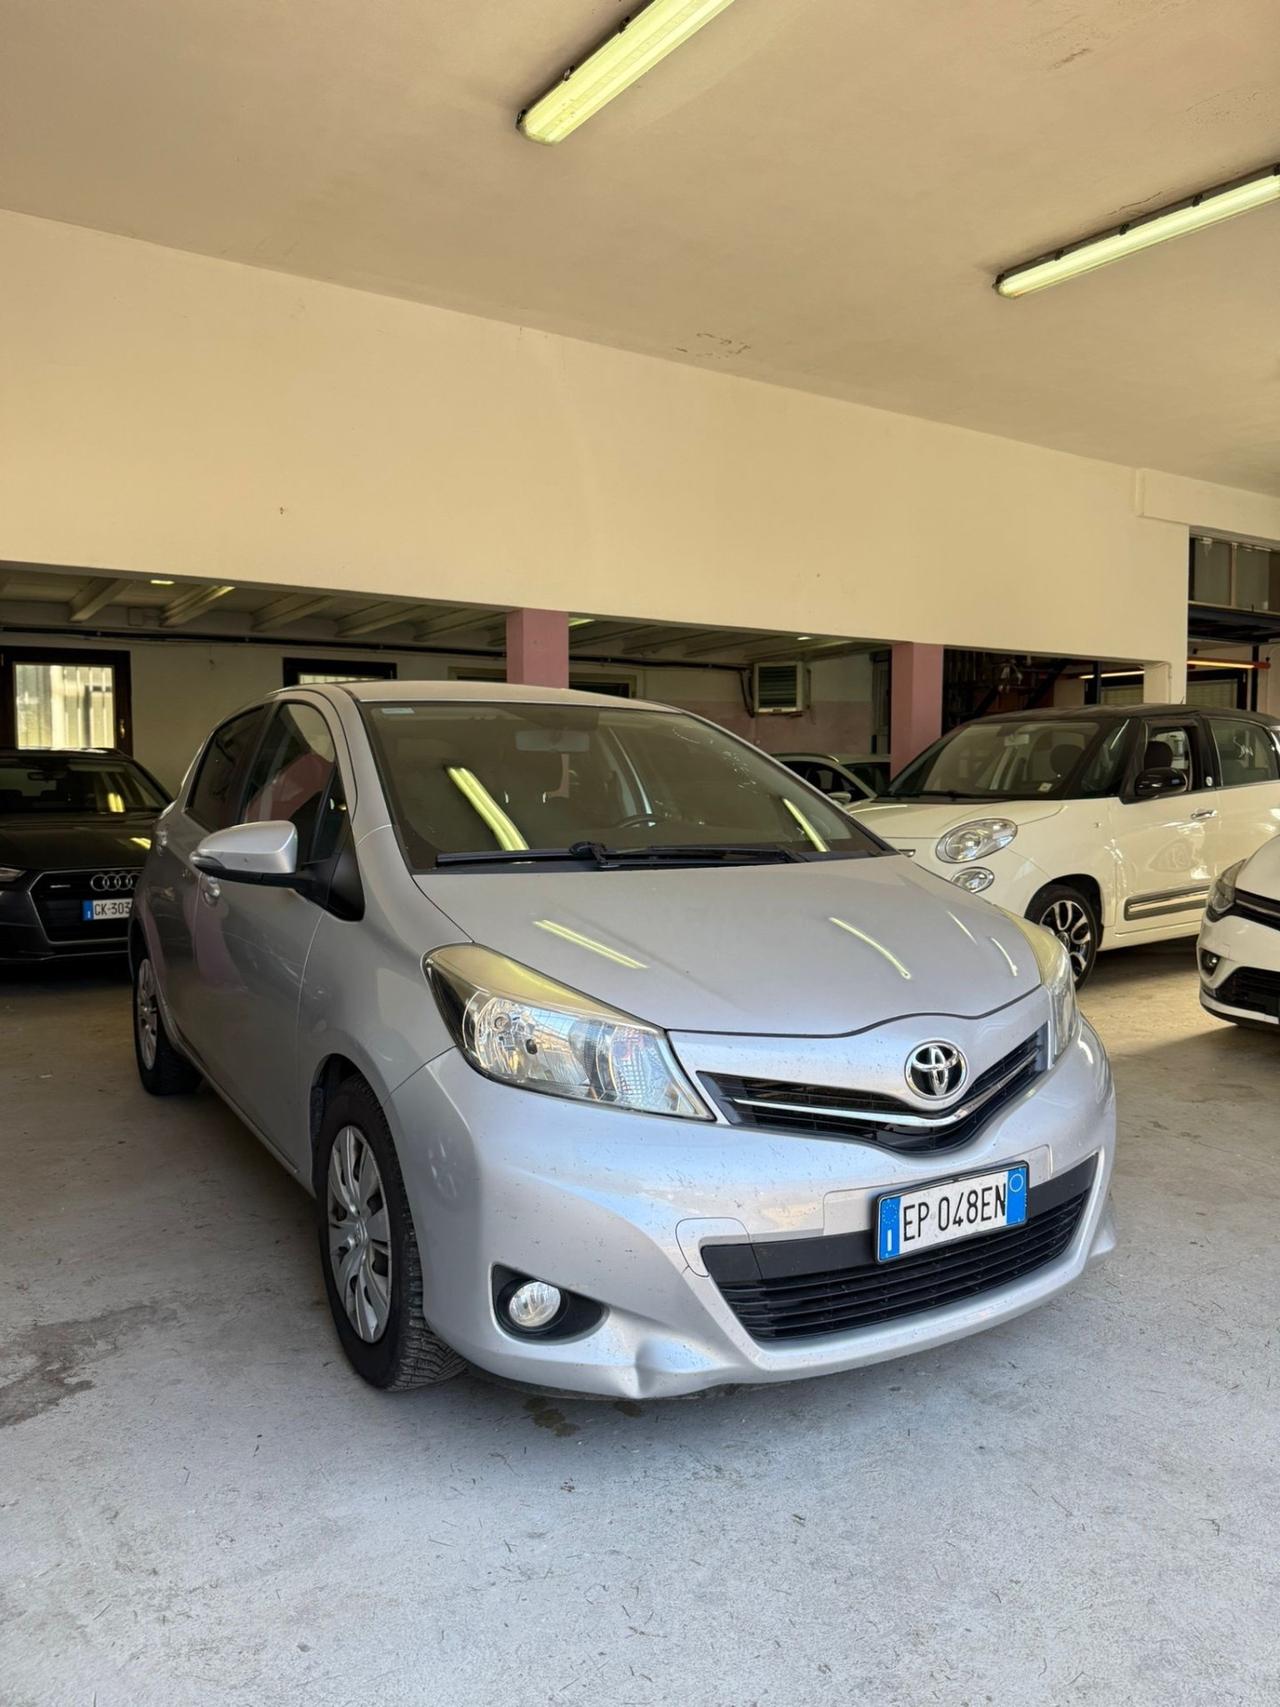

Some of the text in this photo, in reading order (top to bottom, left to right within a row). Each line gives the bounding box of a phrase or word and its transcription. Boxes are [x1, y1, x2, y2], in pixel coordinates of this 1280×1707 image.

[903, 1183, 1007, 1242] EP 048EN
[887, 1229, 892, 1252] I
